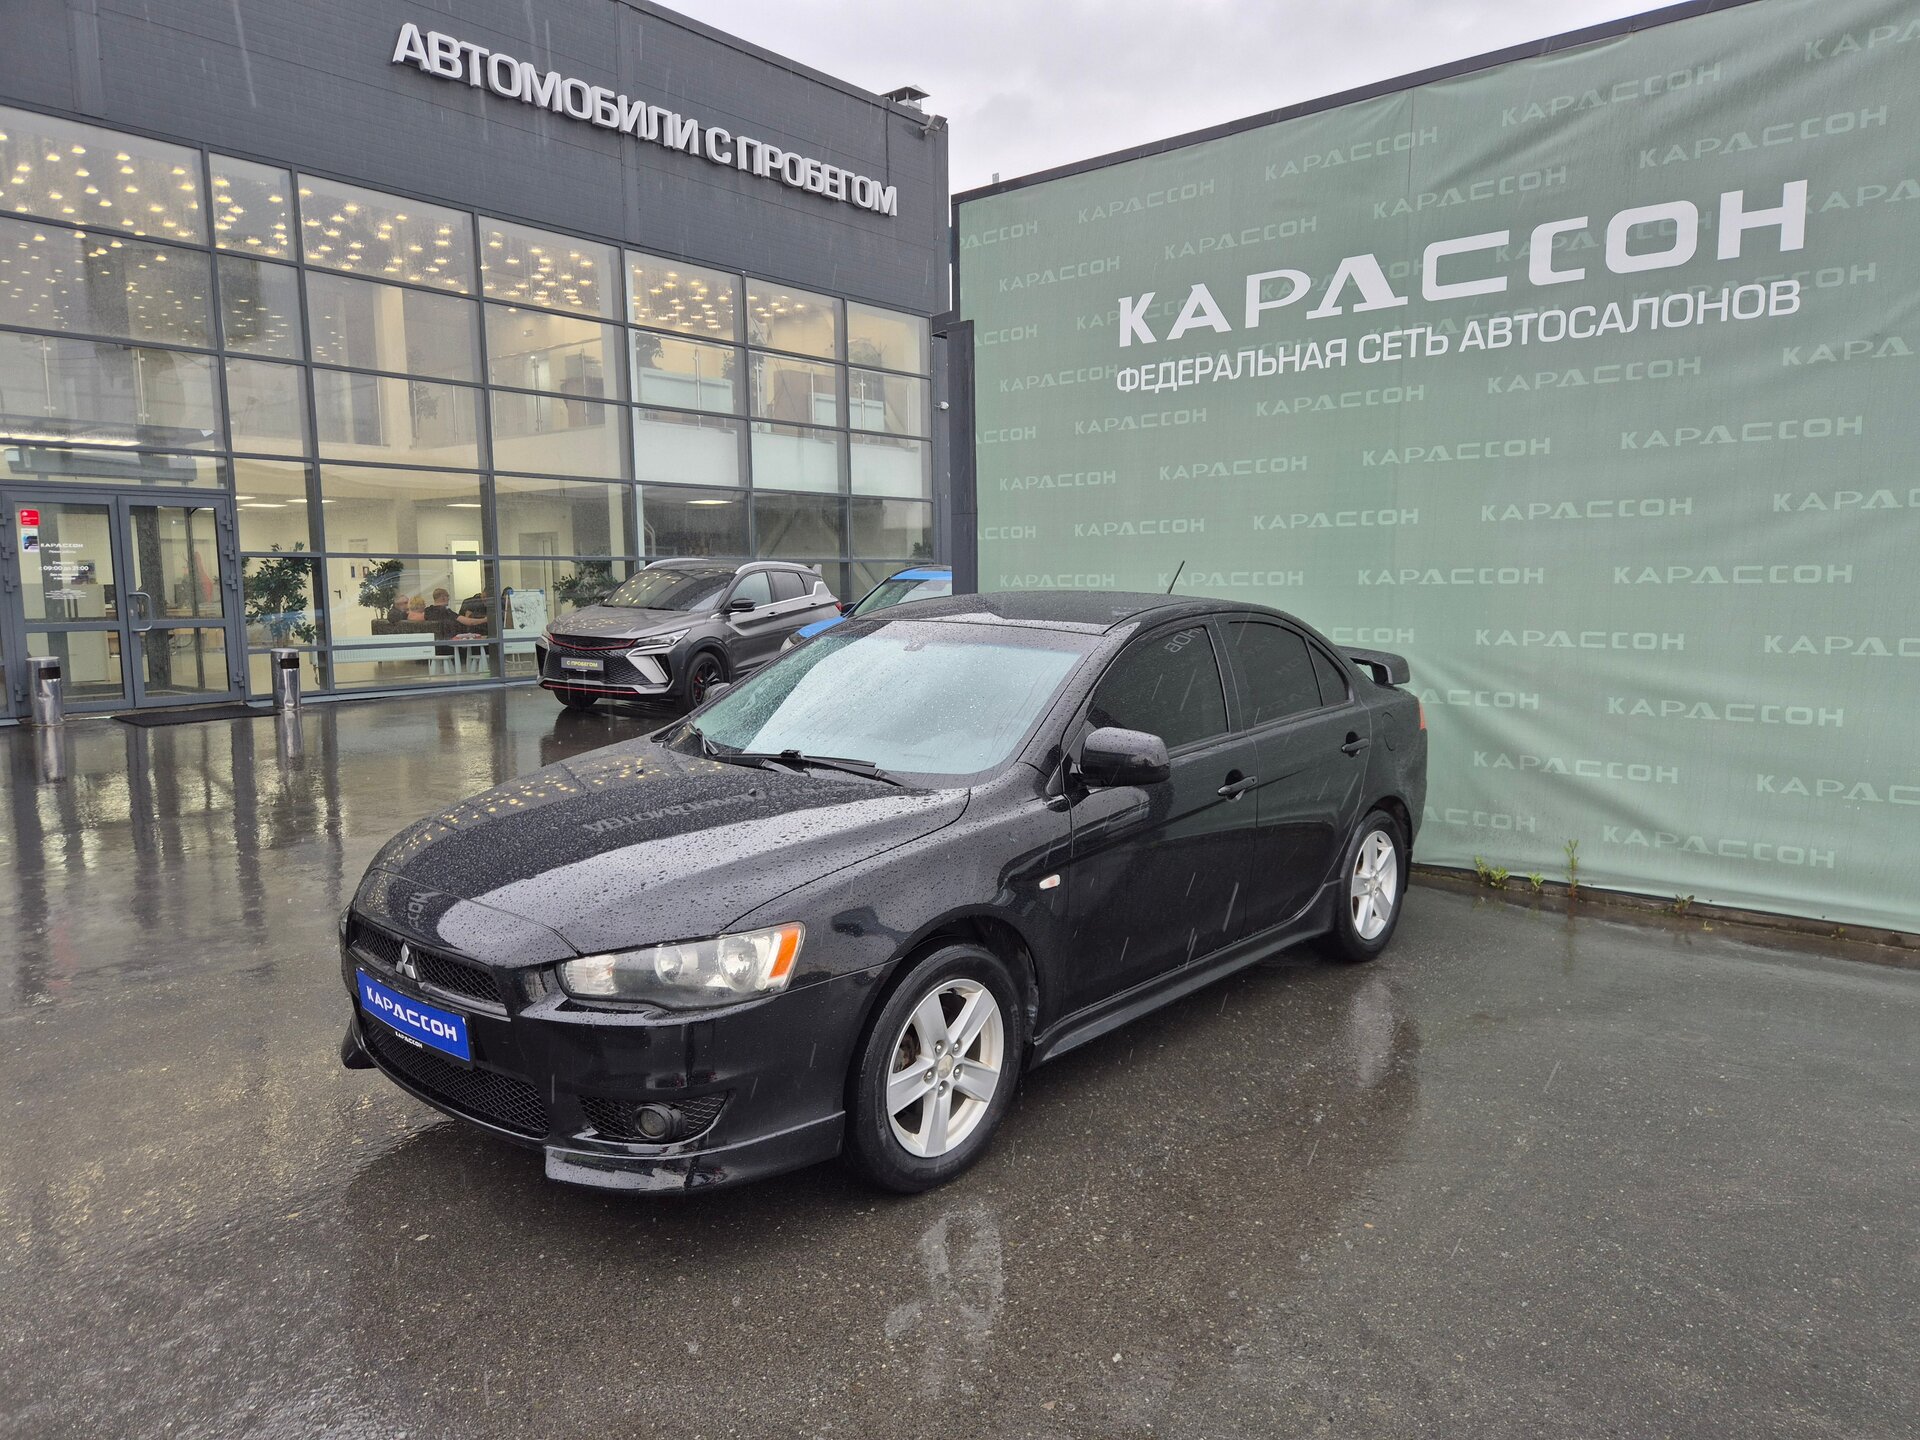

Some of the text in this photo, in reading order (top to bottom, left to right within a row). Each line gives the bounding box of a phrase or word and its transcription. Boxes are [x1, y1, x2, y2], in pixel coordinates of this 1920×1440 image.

[1501, 62, 1721, 127] КАРАССОН
[392, 22, 898, 217] АВТОМОБИЛИ С ПРОБЕГОМ
[1265, 125, 1438, 182] КАРАССОН
[1640, 105, 1888, 169] КАРАССОН
[1078, 179, 1215, 224] КАРАССОН
[1373, 165, 1567, 219] КАРАССОН
[1165, 216, 1317, 260] КАРАССОН
[999, 256, 1120, 293] КАРАССОН
[1118, 179, 1808, 347] КАРАССОН
[1117, 279, 1800, 393] ФЕДЕРАЛЬНАЯ СЕТЬ АВТОСАЛОНОВ
[1488, 356, 1701, 395] КАРАССОН
[1256, 384, 1425, 417] КАРАССОН
[1075, 407, 1207, 435] КАРАССОН
[1620, 415, 1863, 450] КАРАССОН
[1159, 455, 1308, 481] КАРАССОН
[1363, 437, 1551, 466] КАРАССОН
[999, 470, 1116, 492] КАРАССОН
[1254, 508, 1419, 531] КАРАССОН
[1481, 497, 1692, 522] КАРАССОН
[1074, 517, 1205, 538] КАРАССОН
[998, 574, 1115, 588] КАРАССОН
[1158, 570, 1304, 587] КАРАССОН
[1358, 566, 1544, 586] КАРАССОН
[1614, 564, 1853, 585] КАРАССОН
[1476, 628, 1685, 652] КАРАССОН
[1608, 696, 1844, 728] КАРАССОН
[1474, 750, 1679, 784] КАРАССОН
[1602, 825, 1836, 869] КАРАССОН
[366, 985, 458, 1042] КАРАССОН
